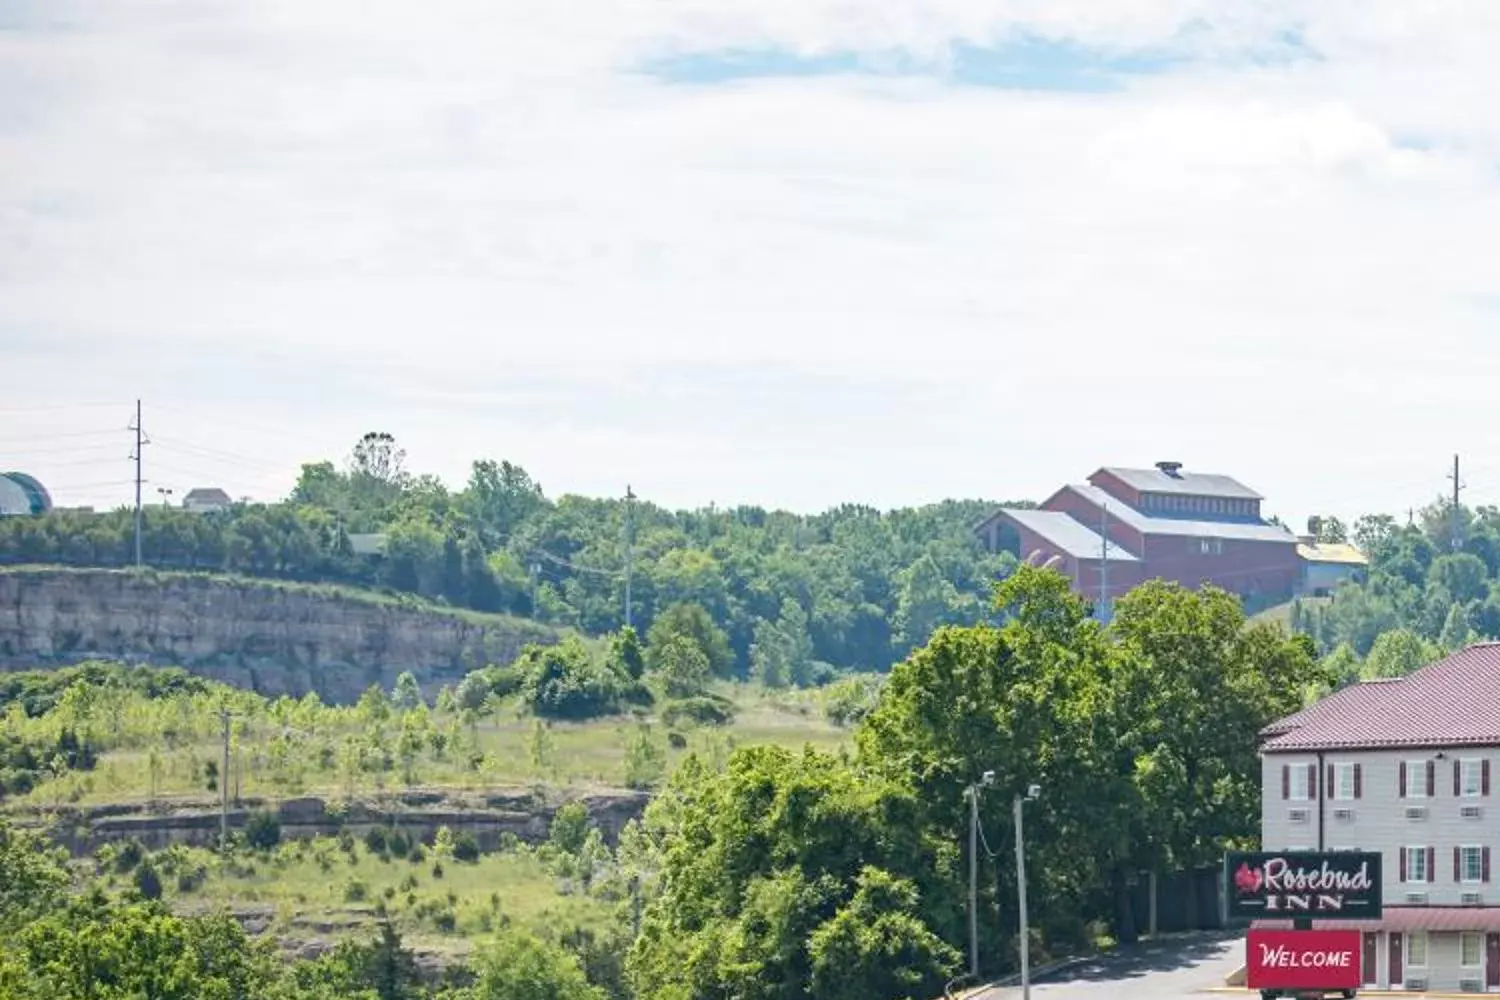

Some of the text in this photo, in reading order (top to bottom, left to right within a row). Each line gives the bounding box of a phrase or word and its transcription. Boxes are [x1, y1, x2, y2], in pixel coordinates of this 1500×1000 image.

[1264, 857, 1373, 892] Rosebud
[1266, 894, 1344, 910] INN
[1259, 943, 1353, 968] WELCOME
